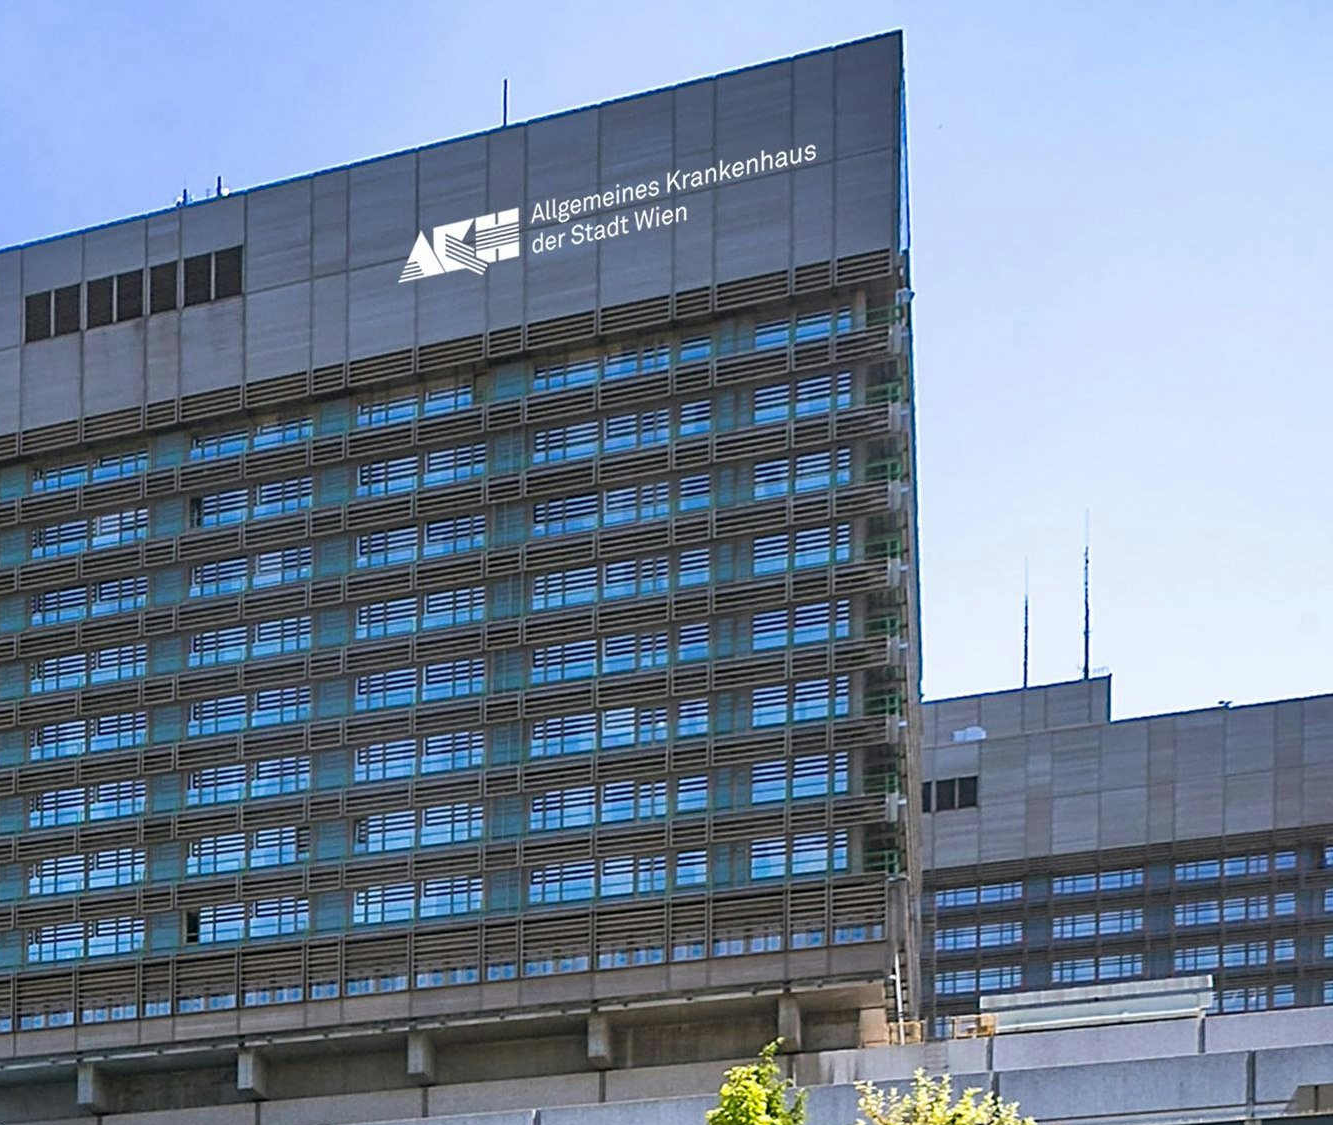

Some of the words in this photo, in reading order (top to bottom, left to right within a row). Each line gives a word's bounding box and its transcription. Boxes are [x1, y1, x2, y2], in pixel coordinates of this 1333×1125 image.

[530, 181, 660, 224] Allgemeines
[666, 144, 817, 193] Krankenhaus
[532, 232, 566, 254] der
[570, 215, 630, 245] Stadt
[634, 206, 687, 231] Wien
